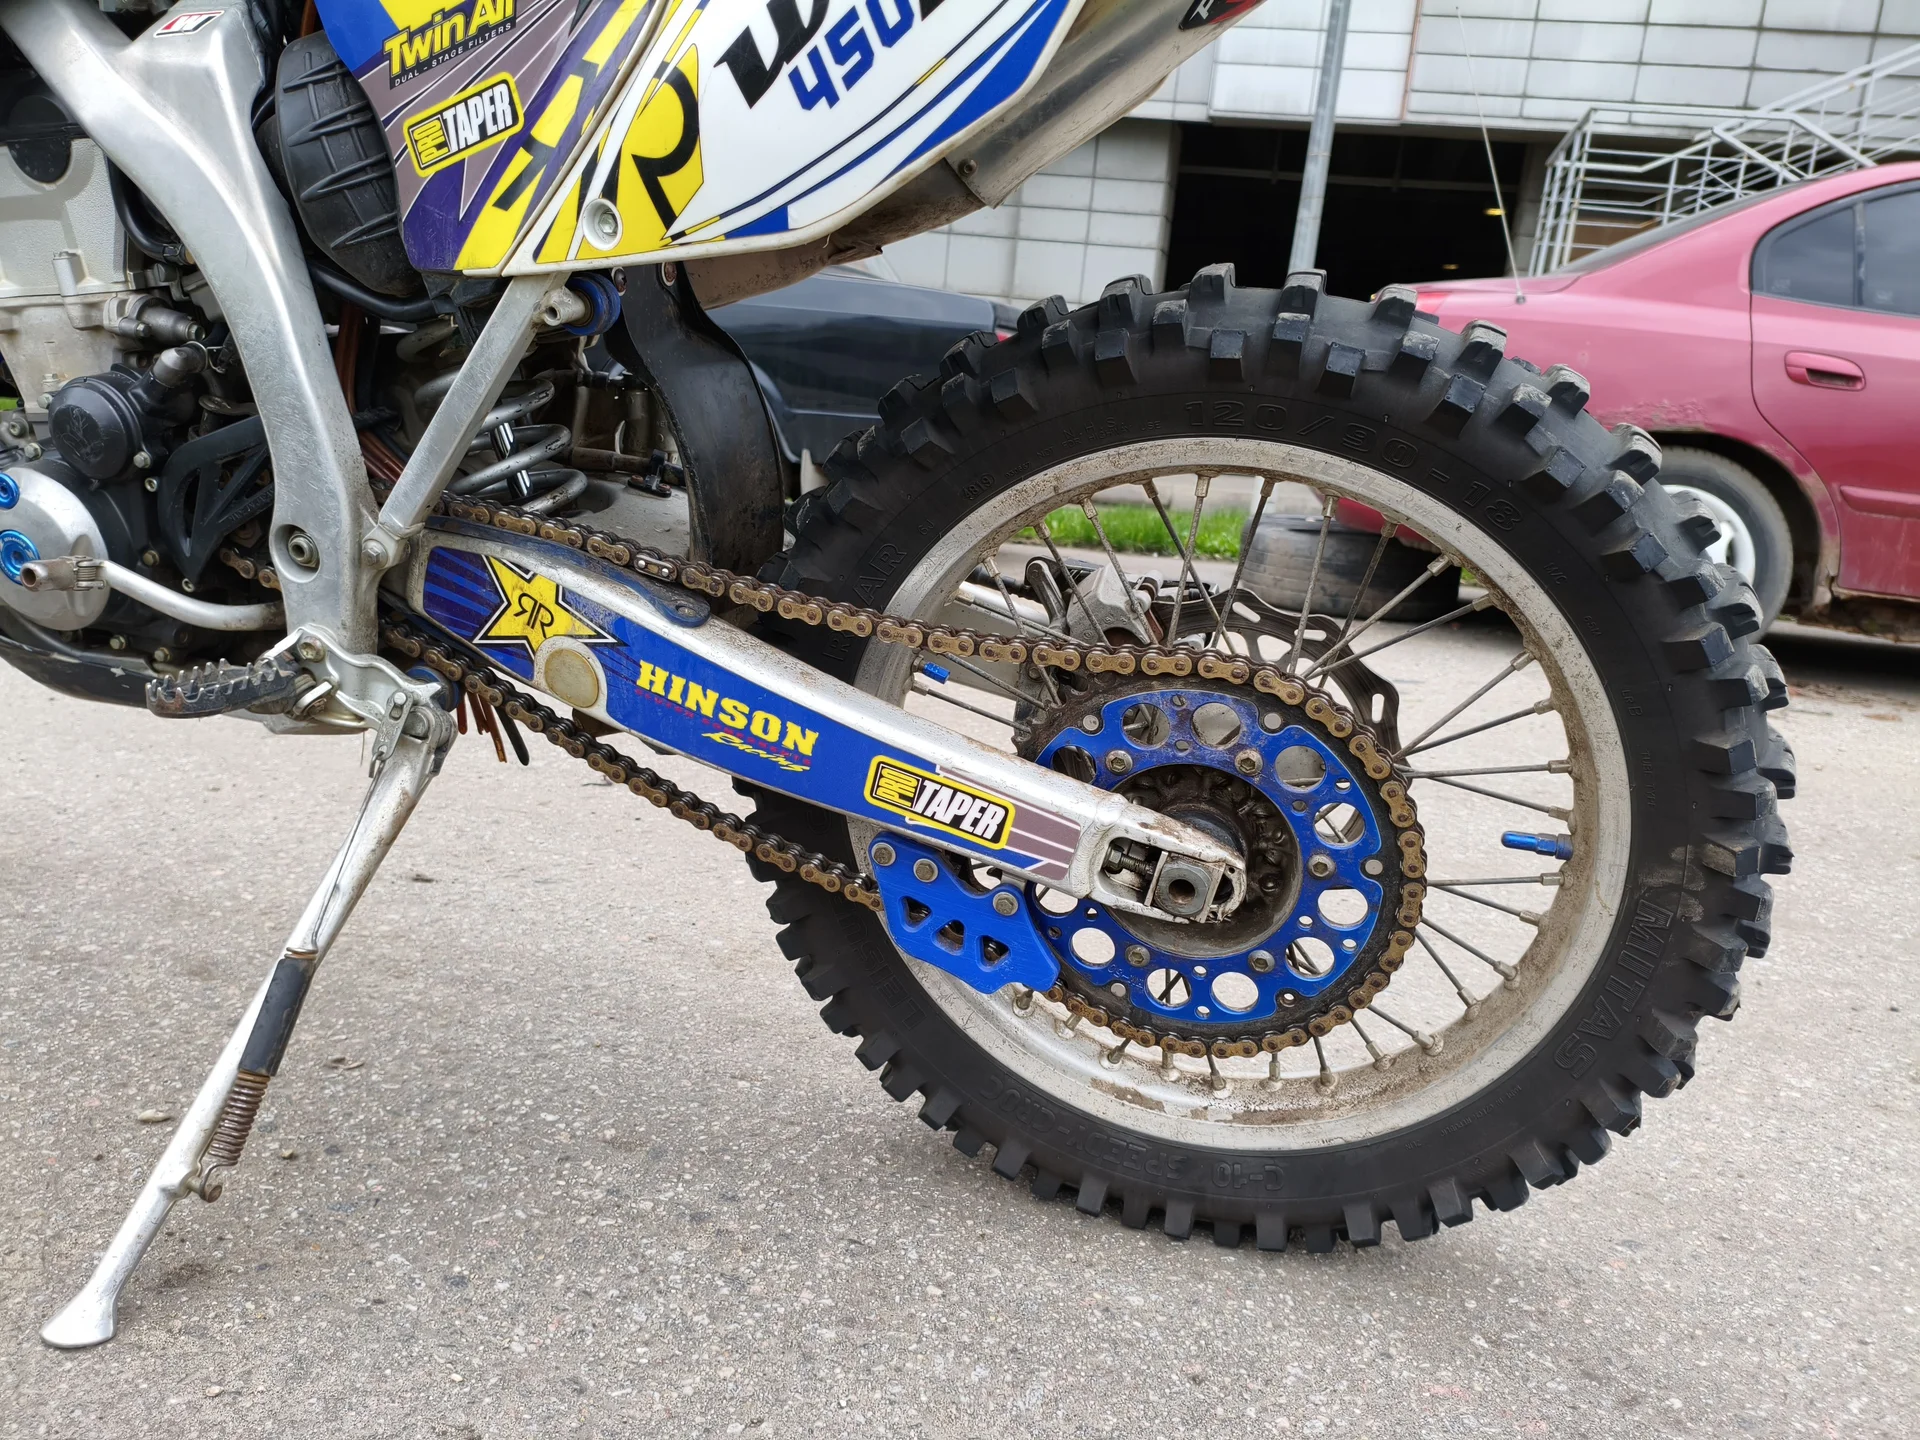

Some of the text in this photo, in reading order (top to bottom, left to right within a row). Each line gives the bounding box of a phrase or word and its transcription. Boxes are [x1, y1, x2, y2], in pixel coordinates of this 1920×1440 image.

[384, 11, 466, 78] Twin
[394, 70, 420, 87] DUAL
[431, 45, 464, 68] STAGE
[468, 22, 512, 49] FILTERS
[412, 83, 513, 165] PRO TAPER
[821, 543, 908, 662] RAR
[636, 659, 819, 757] HINSON
[876, 767, 1006, 840] PRO TAPER
[1553, 899, 1675, 1081] MITAS
